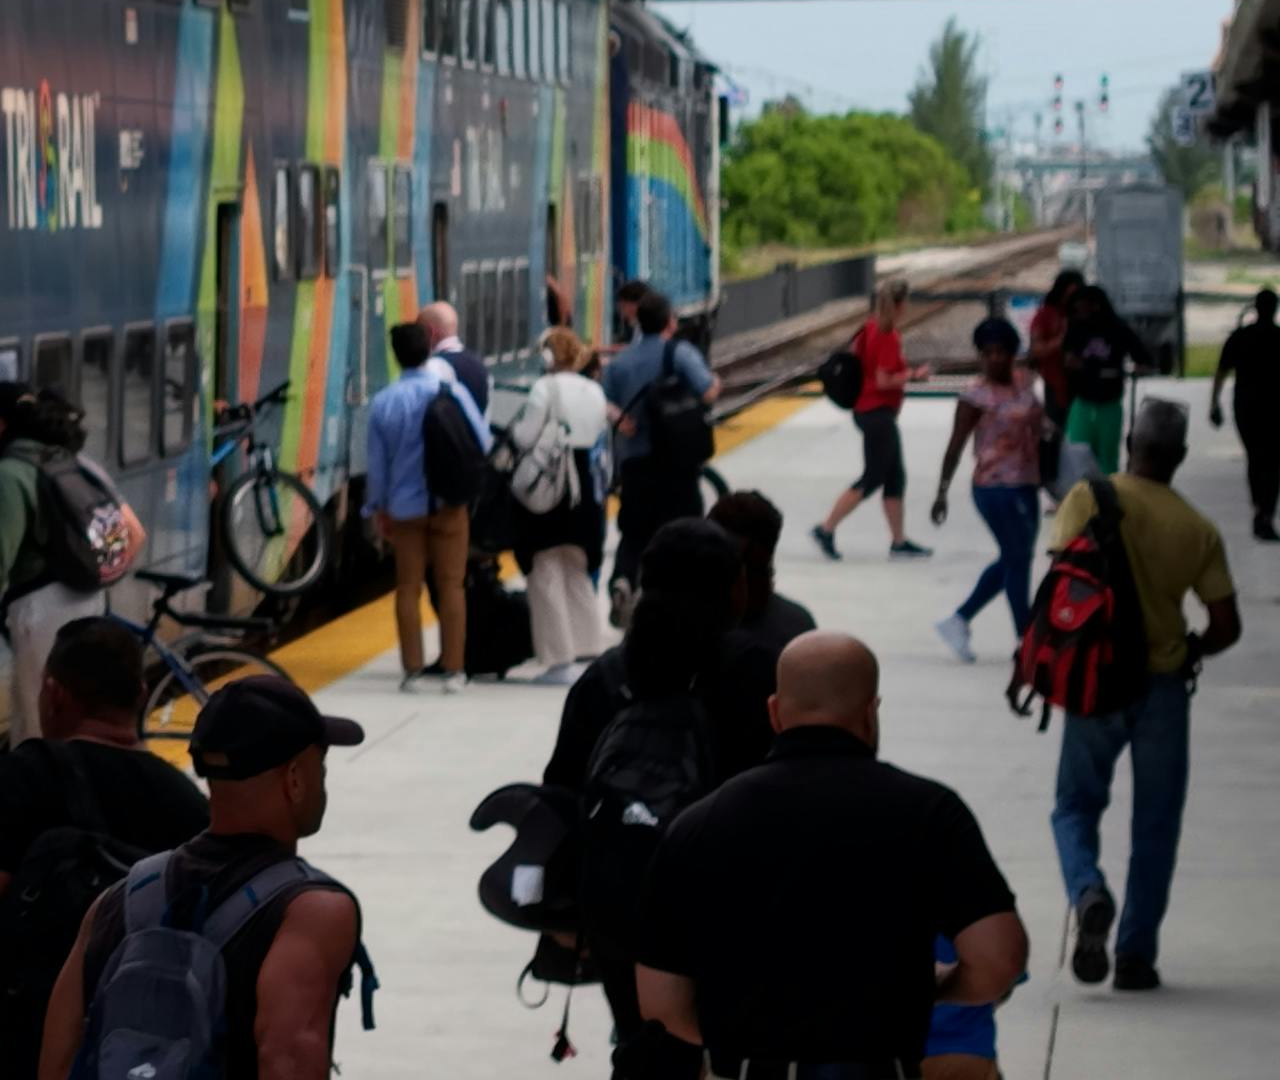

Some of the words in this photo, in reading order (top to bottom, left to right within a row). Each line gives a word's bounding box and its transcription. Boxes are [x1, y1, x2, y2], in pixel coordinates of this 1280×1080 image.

[1188, 73, 1211, 110] 2
[2, 87, 37, 229] TRI
[57, 91, 102, 229] RAIL
